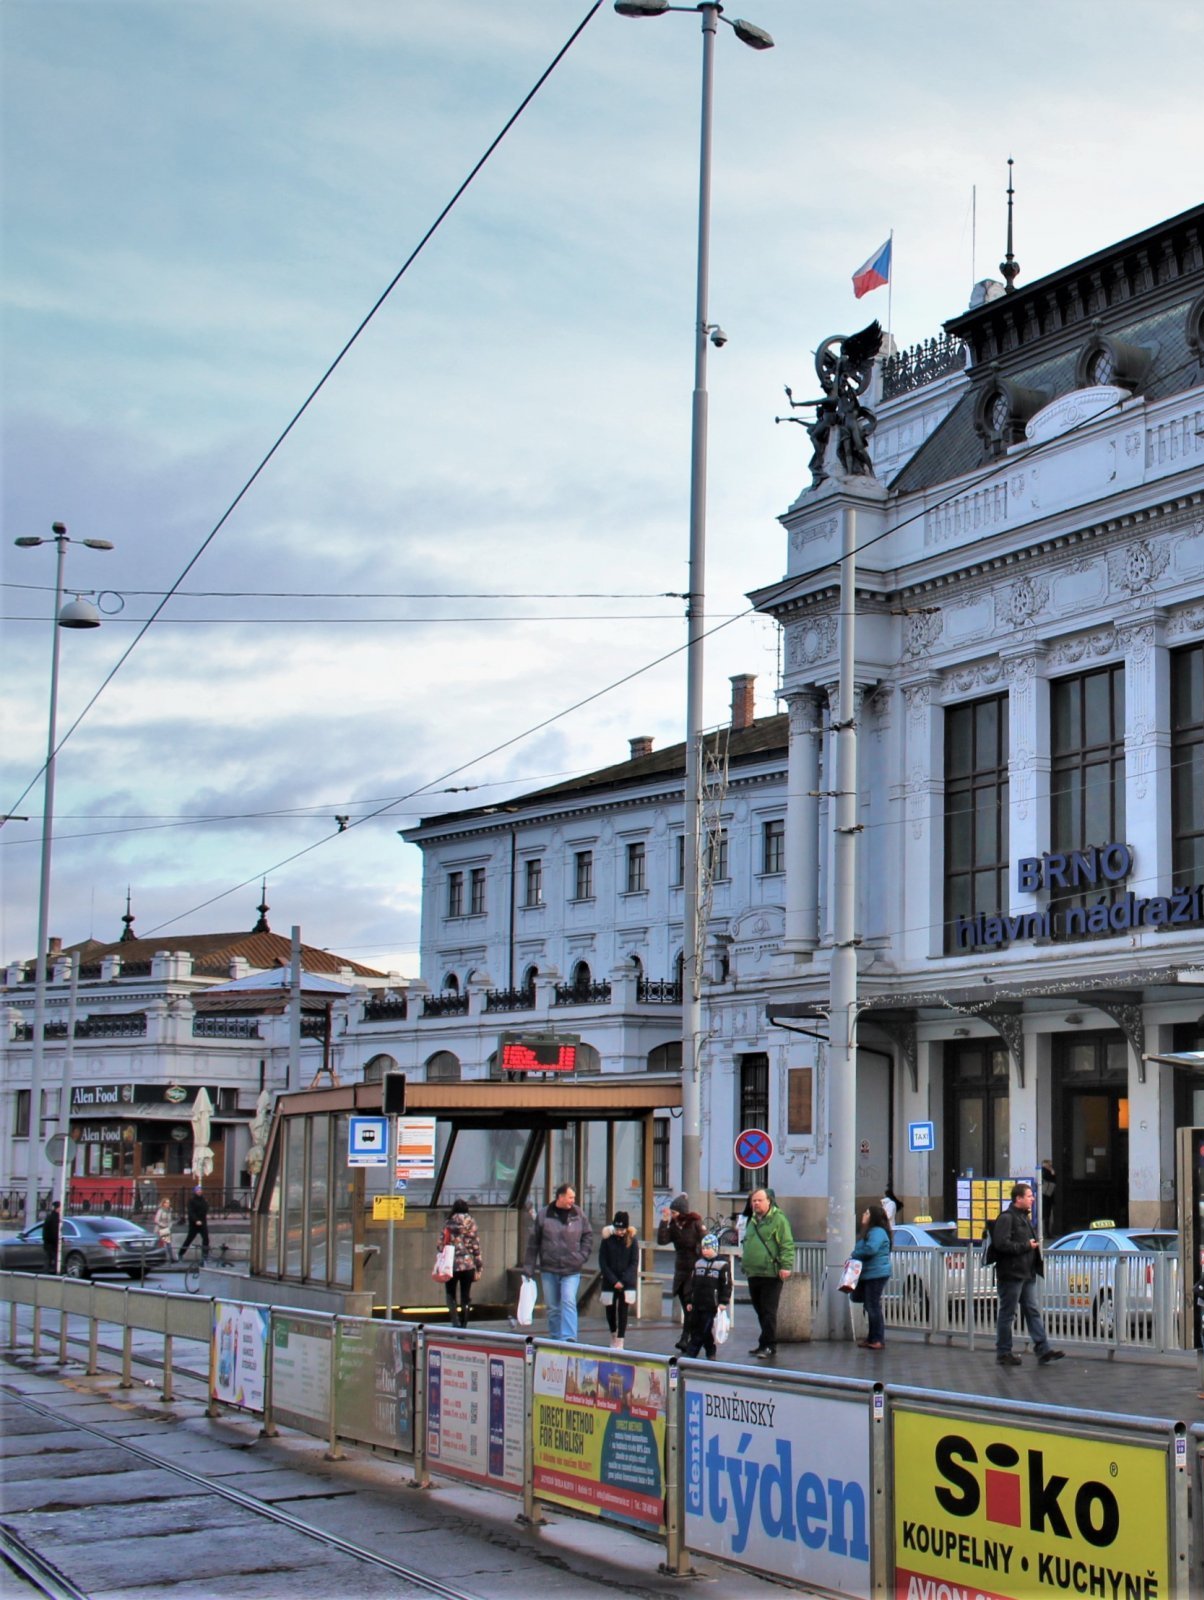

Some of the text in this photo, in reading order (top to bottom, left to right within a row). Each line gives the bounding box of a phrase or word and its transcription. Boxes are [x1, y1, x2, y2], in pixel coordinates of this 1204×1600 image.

[1017, 841, 1135, 894] BRNO
[955, 884, 1204, 949] hlavní nádraží
[73, 1087, 118, 1104] Alen Food
[81, 1126, 121, 1141] Alen Food
[915, 1133, 929, 1141] TAXI
[540, 1404, 594, 1435] DIRECT METHOD
[705, 1392, 775, 1428] BRNĚNSKÝ
[539, 1425, 584, 1455] FOR ENGLISH
[705, 1432, 870, 1562] týden
[934, 1434, 1120, 1548] Siko
[902, 1520, 1158, 1600] KOUPELNY KUCHYNĚ
